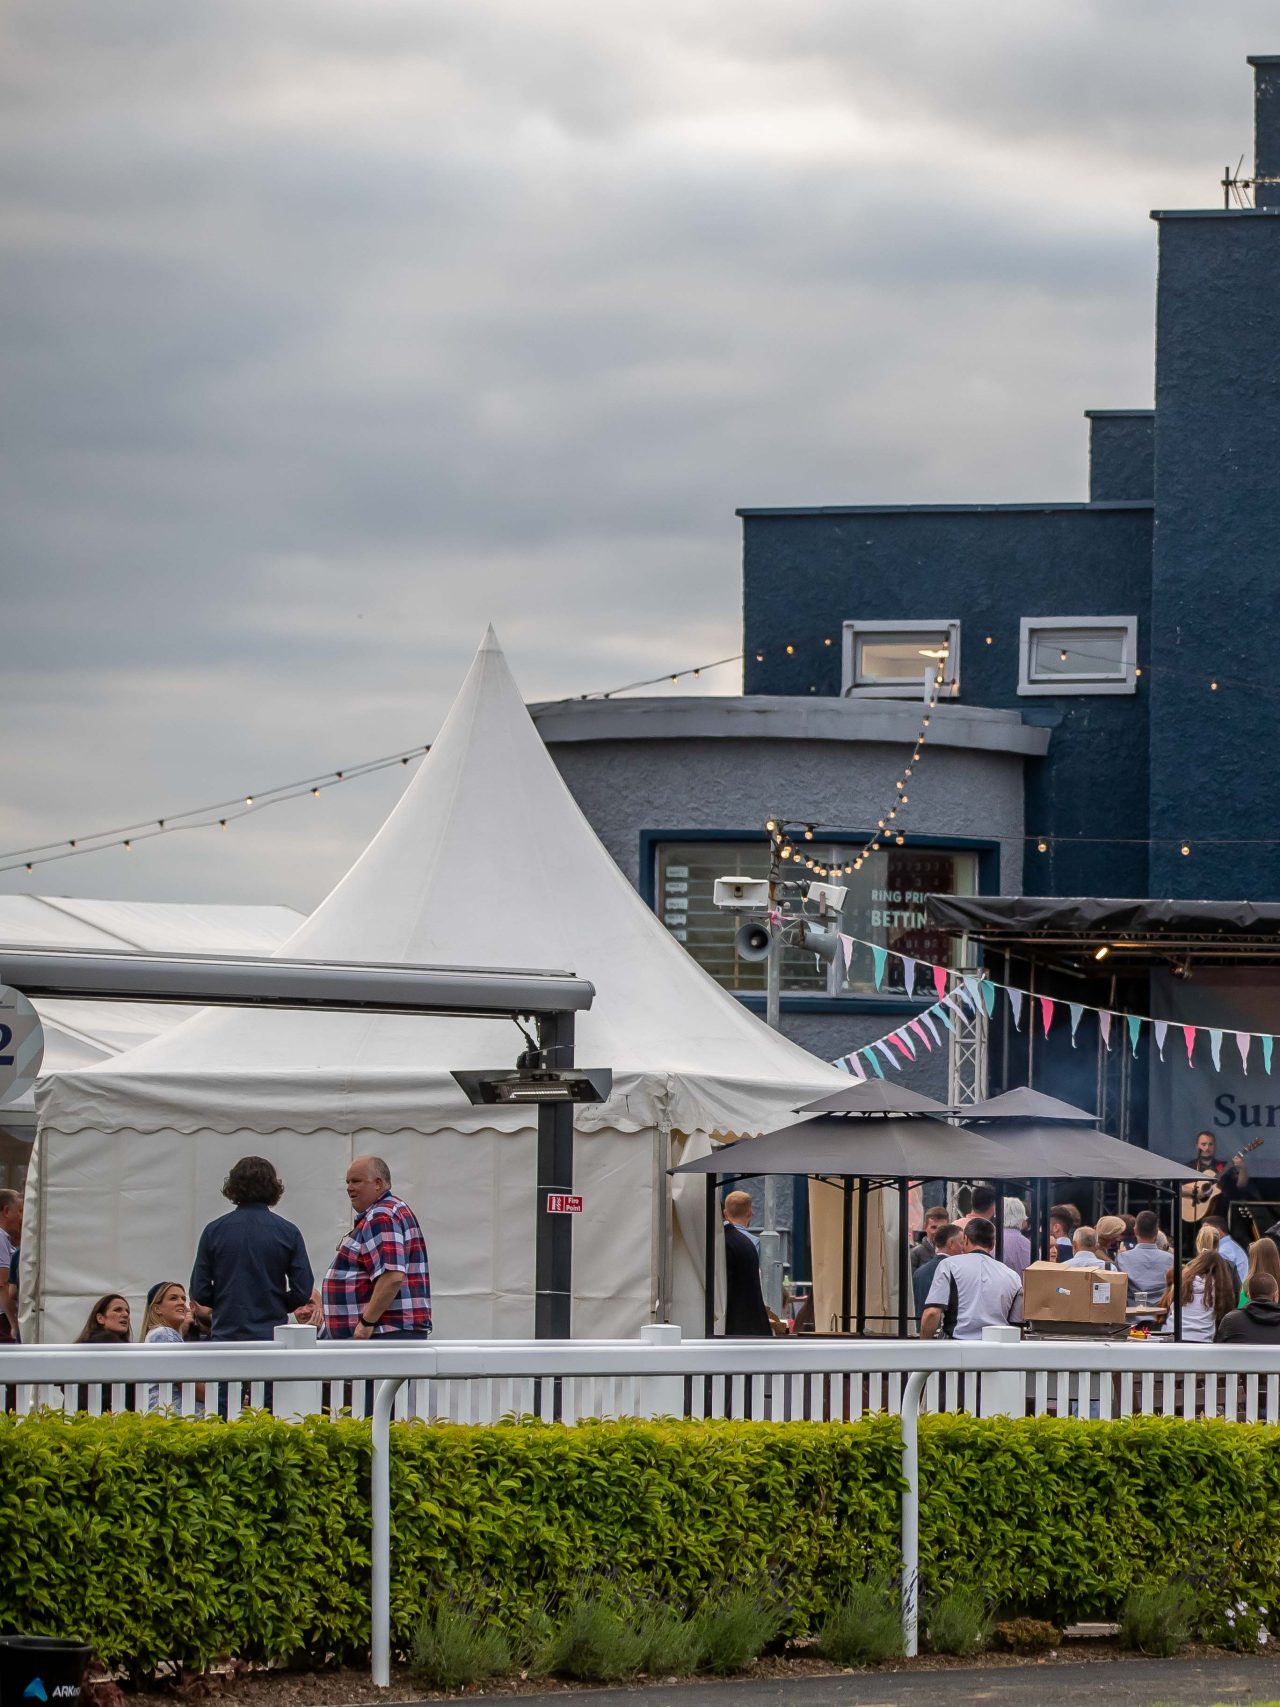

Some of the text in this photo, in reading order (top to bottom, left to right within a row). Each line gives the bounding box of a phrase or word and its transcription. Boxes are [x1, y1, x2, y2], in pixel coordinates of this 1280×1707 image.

[871, 889, 902, 903] RING
[871, 910, 928, 929] BETTIN
[566, 1204, 581, 1212] Point
